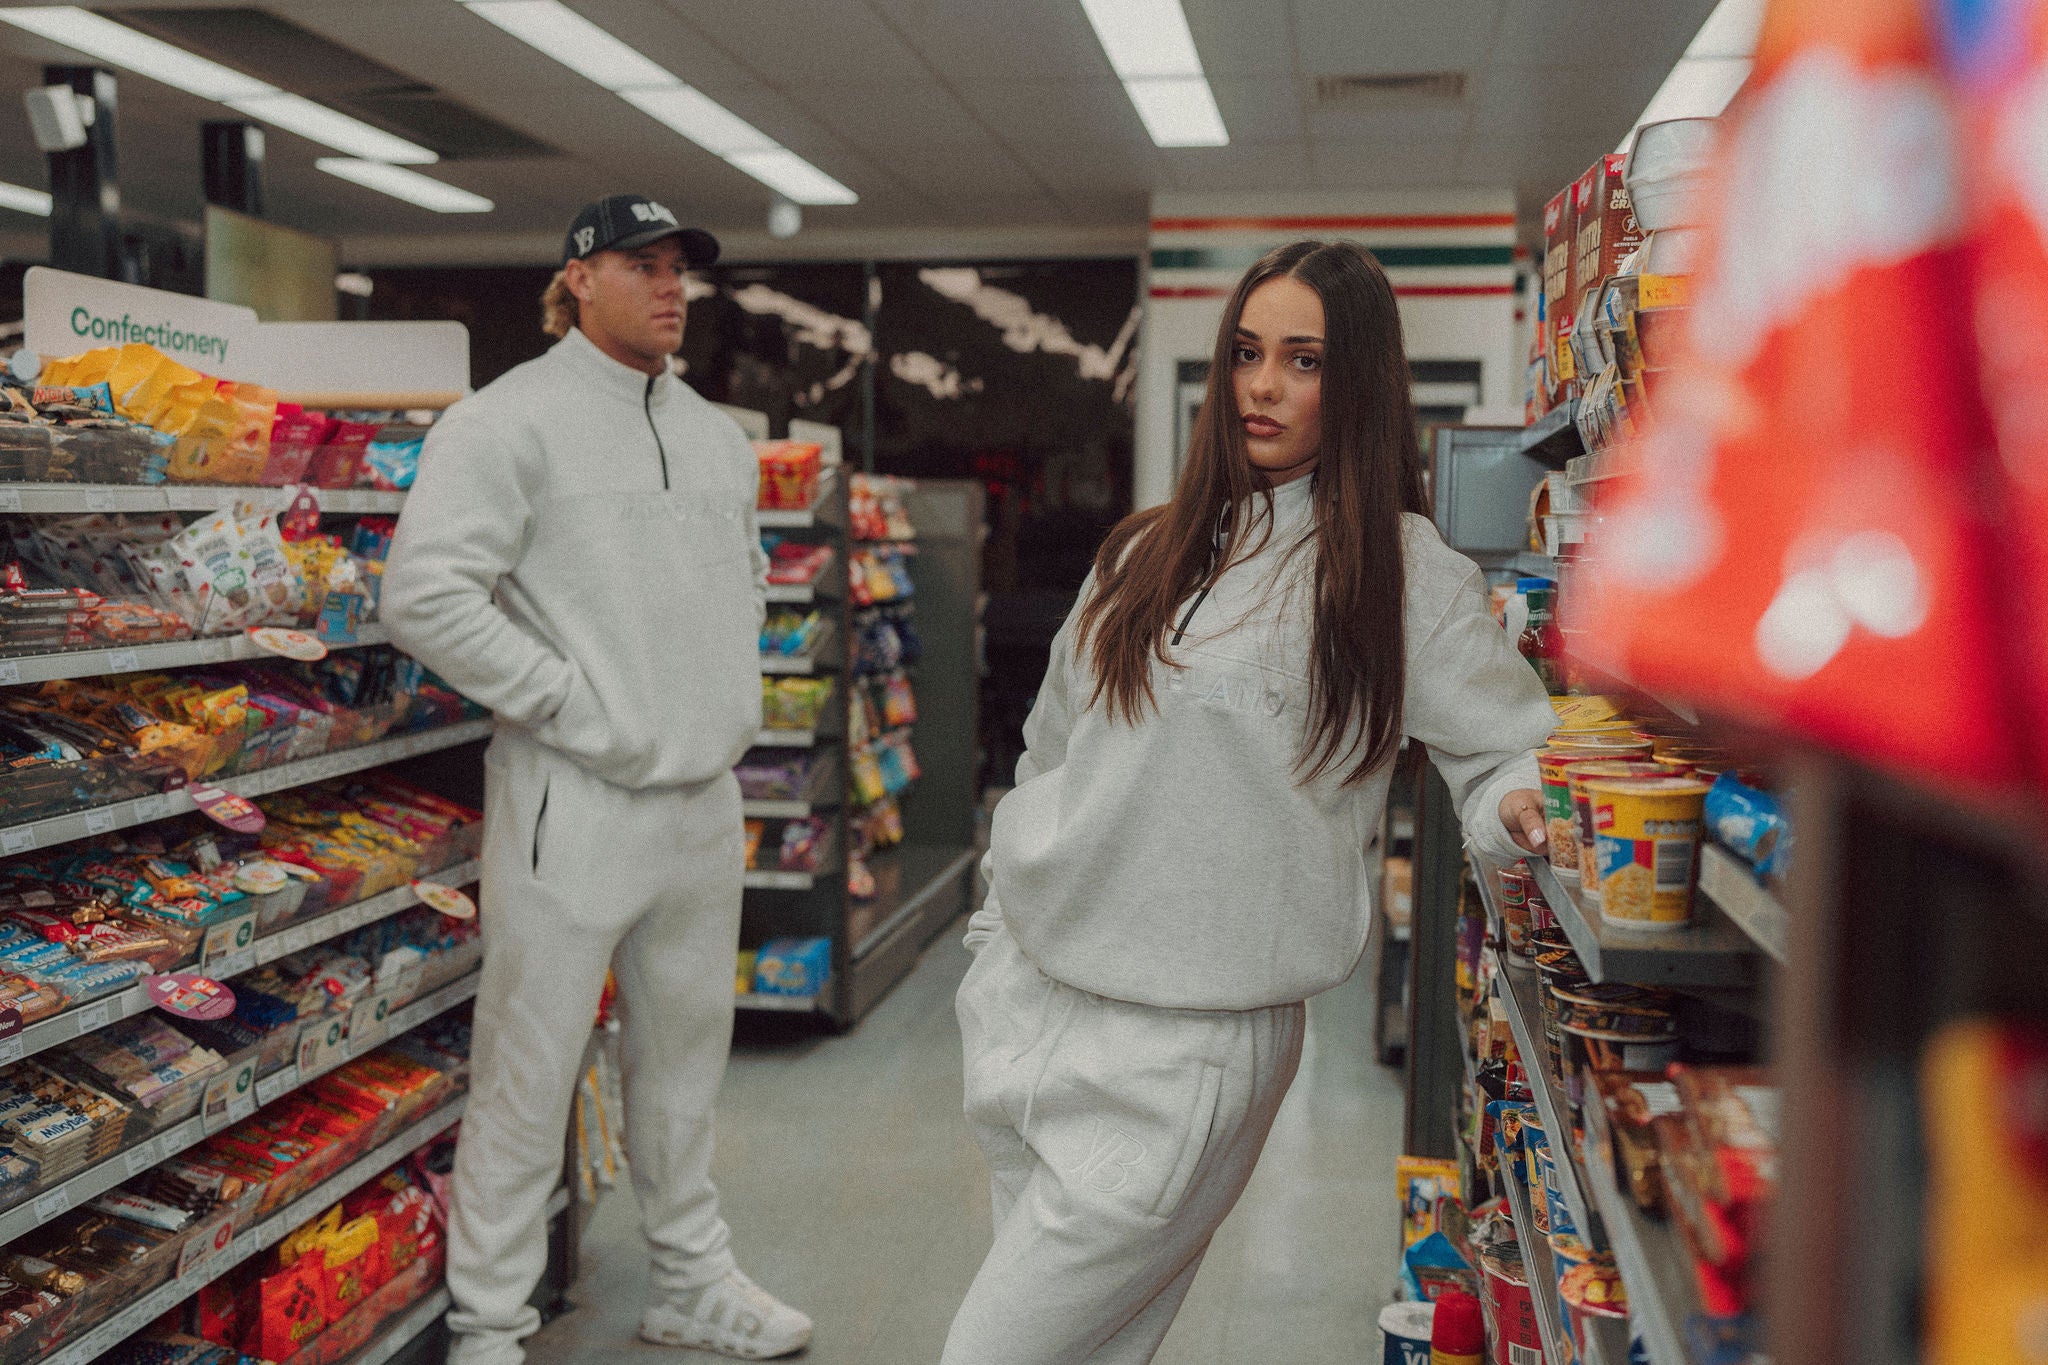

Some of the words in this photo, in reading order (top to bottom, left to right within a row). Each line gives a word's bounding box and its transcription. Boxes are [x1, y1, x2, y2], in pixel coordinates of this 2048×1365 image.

[71, 307, 229, 363] Confectionery
[16, 1103, 67, 1126] Milkybar
[40, 1113, 89, 1139] Milkybar
